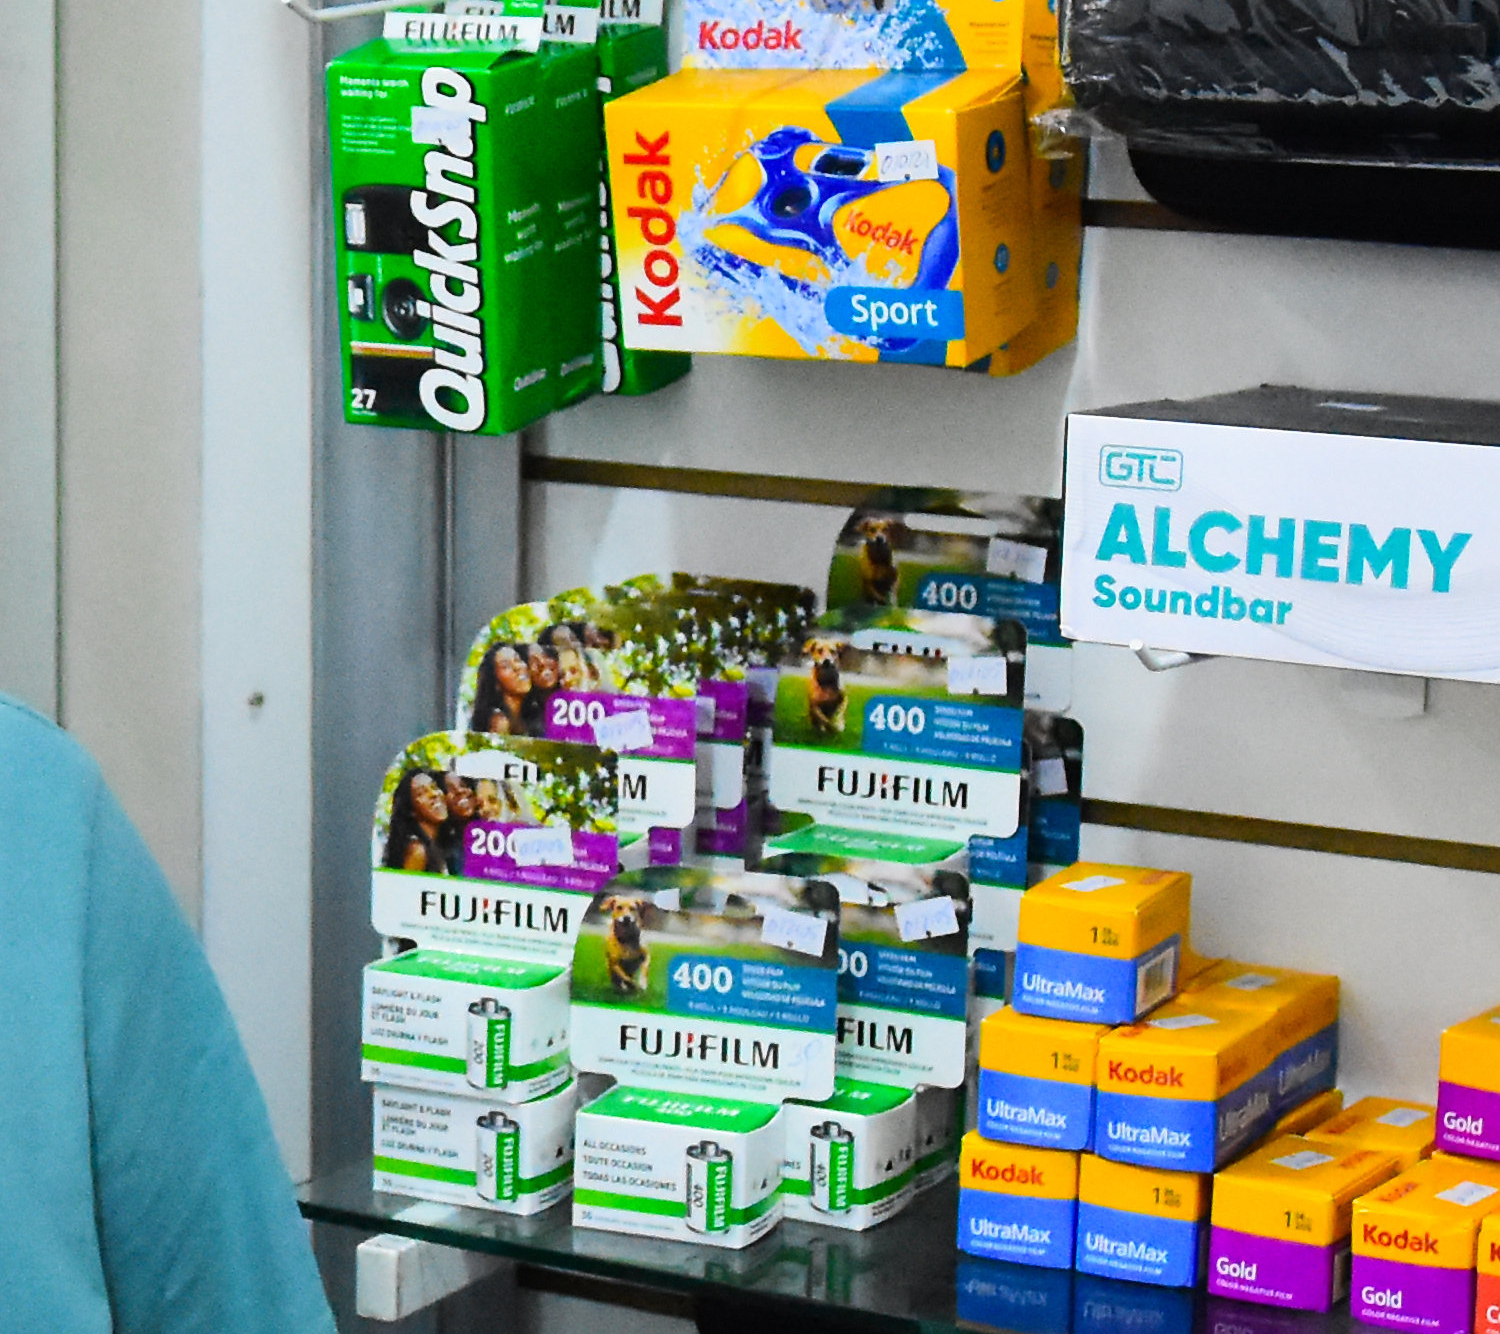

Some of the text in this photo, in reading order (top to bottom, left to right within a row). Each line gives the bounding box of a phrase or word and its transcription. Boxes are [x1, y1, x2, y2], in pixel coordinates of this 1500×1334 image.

[699, 20, 802, 51] Kodak
[623, 130, 683, 326] Kodak
[846, 210, 919, 255] Kodak
[851, 294, 938, 332] Sport
[351, 389, 377, 410] 27
[1095, 502, 1472, 594] ALCHEMY
[922, 580, 978, 611] 400
[1091, 574, 1293, 627] Soundbar
[552, 698, 606, 727] 200
[869, 703, 926, 735] 400
[817, 765, 969, 810] FUJIFILM
[420, 890, 569, 934] FUJIFILM
[673, 962, 733, 994] 400
[1022, 972, 1106, 1004] UltraMax
[620, 1025, 780, 1069] FUJIFILM
[1109, 1060, 1184, 1087] Kodak
[987, 1099, 1067, 1129] UltraMax
[1443, 1111, 1483, 1136] Gold
[1108, 1122, 1191, 1147] UltraMax
[971, 1159, 1044, 1186] Kodak
[970, 1218, 1051, 1244] UltraMax
[1363, 1223, 1438, 1255] Kodak
[1085, 1232, 1169, 1264] UltraMax
[1216, 1256, 1257, 1281] Gold
[1361, 1286, 1402, 1309] Gold
